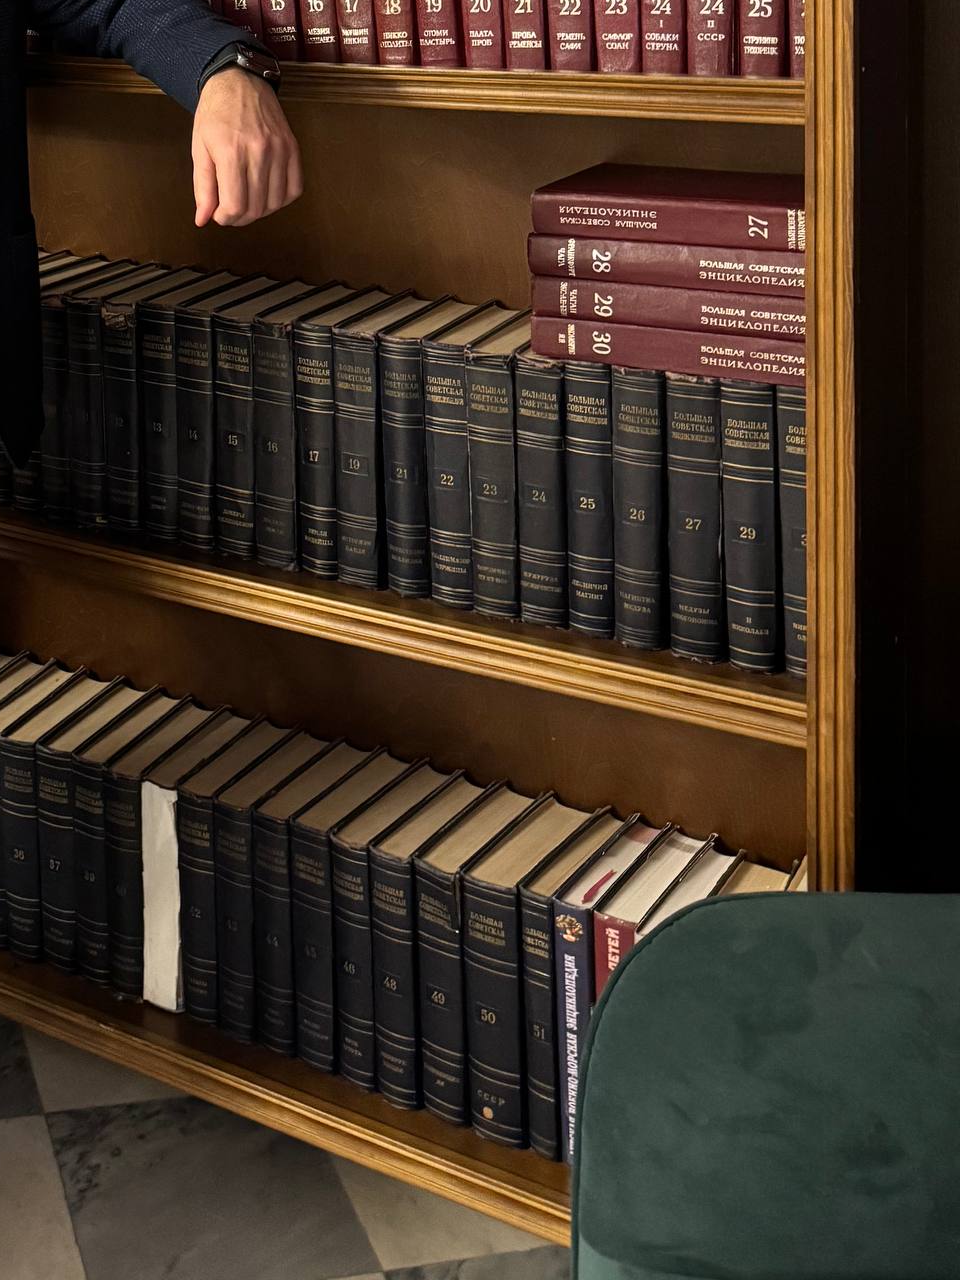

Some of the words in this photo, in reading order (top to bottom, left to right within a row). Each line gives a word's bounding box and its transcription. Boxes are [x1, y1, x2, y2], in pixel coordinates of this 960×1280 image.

[423, 29, 449, 37] ОТОМИ
[469, 30, 494, 38] ПЛАТА
[511, 31, 537, 39] ПРОБА
[556, 32, 586, 41] РЕМЕНЬ
[601, 33, 634, 41] САФЛОР
[645, 33, 679, 42] СОБАКИ
[697, 33, 726, 41] СССР
[419, 38, 456, 46] ПЛАСТЫРЬ
[471, 39, 493, 47] ПРОБ
[645, 42, 679, 51] СТРУНА
[743, 36, 779, 45] СТРУНИНО
[559, 205, 657, 219] ЭНЦИКЛОПЕДИЯ
[559, 216, 611, 227] СОВЕТСКАЯ
[615, 220, 658, 230] БОЛЬШАЯ
[748, 215, 768, 239] 27
[592, 248, 612, 273] 28
[699, 260, 745, 271] БОЛЬШАЯ
[748, 264, 805, 276] СОВЕТСКАЯ
[699, 271, 805, 288] ЭНЦИКЛОПЕДИЯ
[593, 292, 613, 318] 29
[701, 305, 746, 317] БОЛЬШАЯ
[750, 310, 807, 323] СОВЕТСКАЯ
[700, 316, 806, 335] ЭНЦИКЛОПЕДИЯ
[592, 330, 612, 355] 30
[700, 345, 745, 357] БОЛЬШАЯ
[749, 351, 805, 364] СОВЕТСКАЯ
[700, 356, 805, 377] ЭНЦИКЛОПЕДИЯ
[427, 375, 461, 387] БОЛЬШАЯ
[568, 393, 605, 406] БОЛЬШАЯ
[727, 418, 767, 430] БОЛЬШАЯ
[228, 434, 238, 446] 15
[725, 428, 770, 440] СОВЕТСКАЯ
[308, 450, 320, 462] 17
[348, 458, 360, 470] 19
[396, 467, 408, 480] 21
[439, 473, 455, 487] 22
[483, 482, 498, 496] 23
[531, 489, 547, 503] 24
[579, 496, 596, 510] 25
[629, 508, 646, 521] 26
[685, 517, 702, 531] 27
[739, 526, 756, 540] 29
[469, 911, 503, 929] БОЛЬШАЯ
[468, 920, 505, 937] СОВЕТСКАЯ
[383, 976, 397, 991] 48
[431, 991, 446, 1005] 49
[564, 953, 580, 1031] ЭНЦИКЛОПЕДИЯ
[480, 1009, 496, 1025] 50
[476, 1090, 506, 1107] СССР
